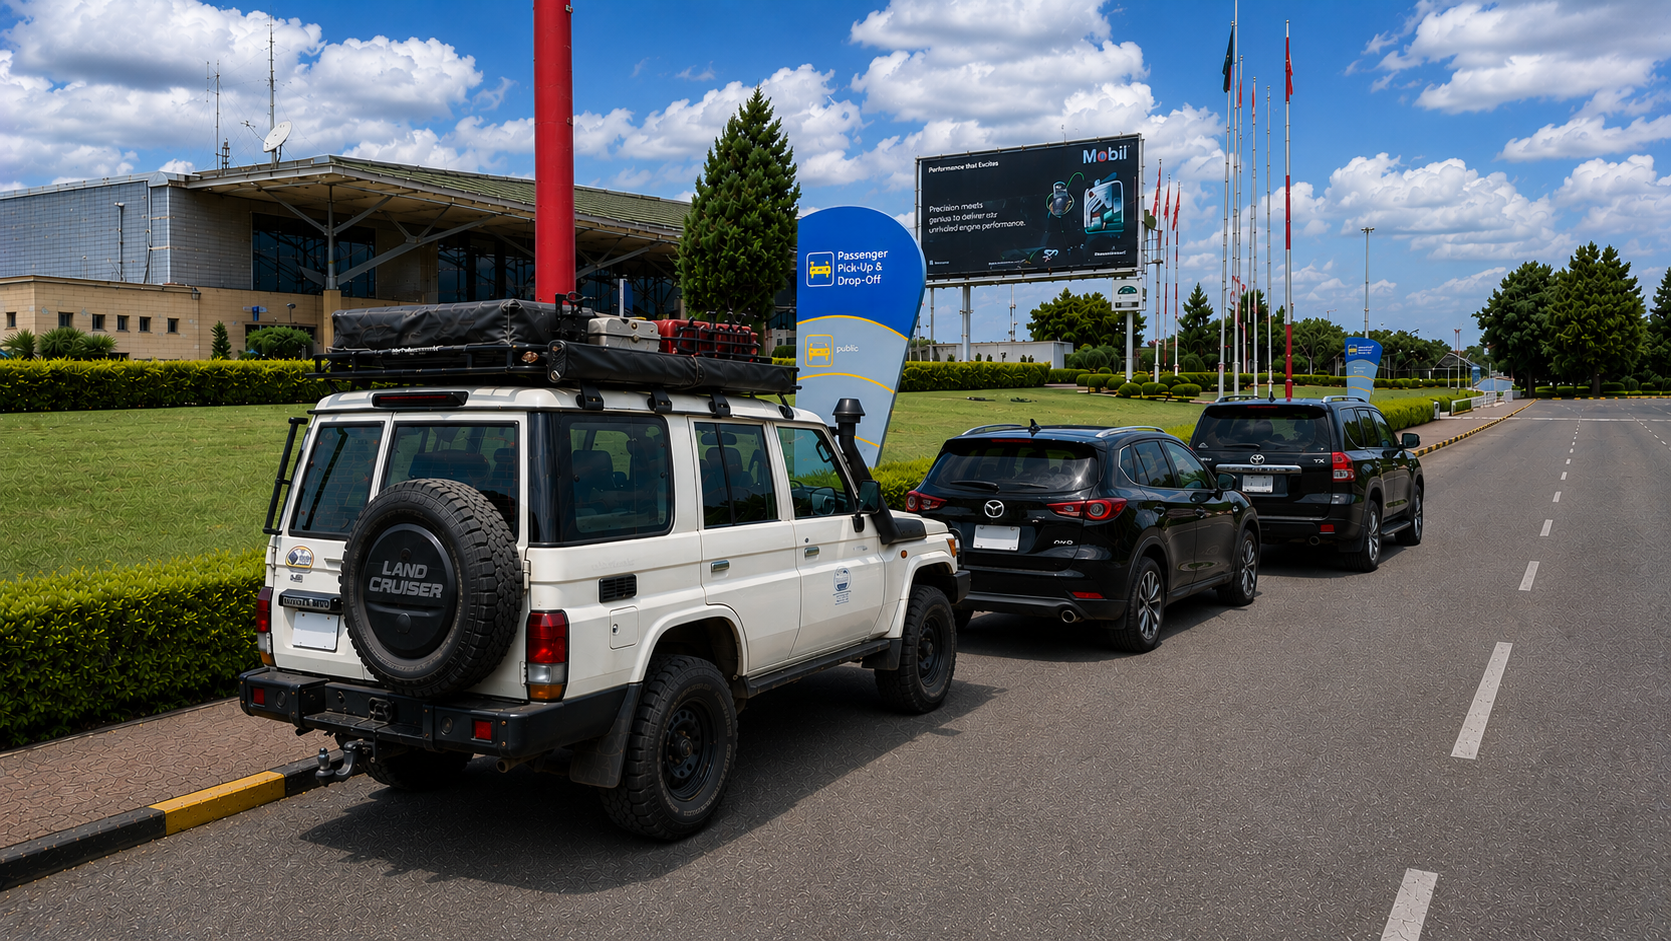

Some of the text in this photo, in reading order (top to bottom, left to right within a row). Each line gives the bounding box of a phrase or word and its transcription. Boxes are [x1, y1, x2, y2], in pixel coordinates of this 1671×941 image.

[1082, 145, 1127, 164] Mobil
[928, 164, 965, 173] Performance
[965, 162, 978, 170] that
[929, 204, 960, 213] Precision
[837, 250, 889, 262] Passenger
[837, 262, 883, 273] Pick-Up &
[837, 275, 882, 287] Drop-Off
[836, 345, 859, 354] public
[381, 560, 428, 579] LAND
[368, 577, 444, 599] CRUISER
